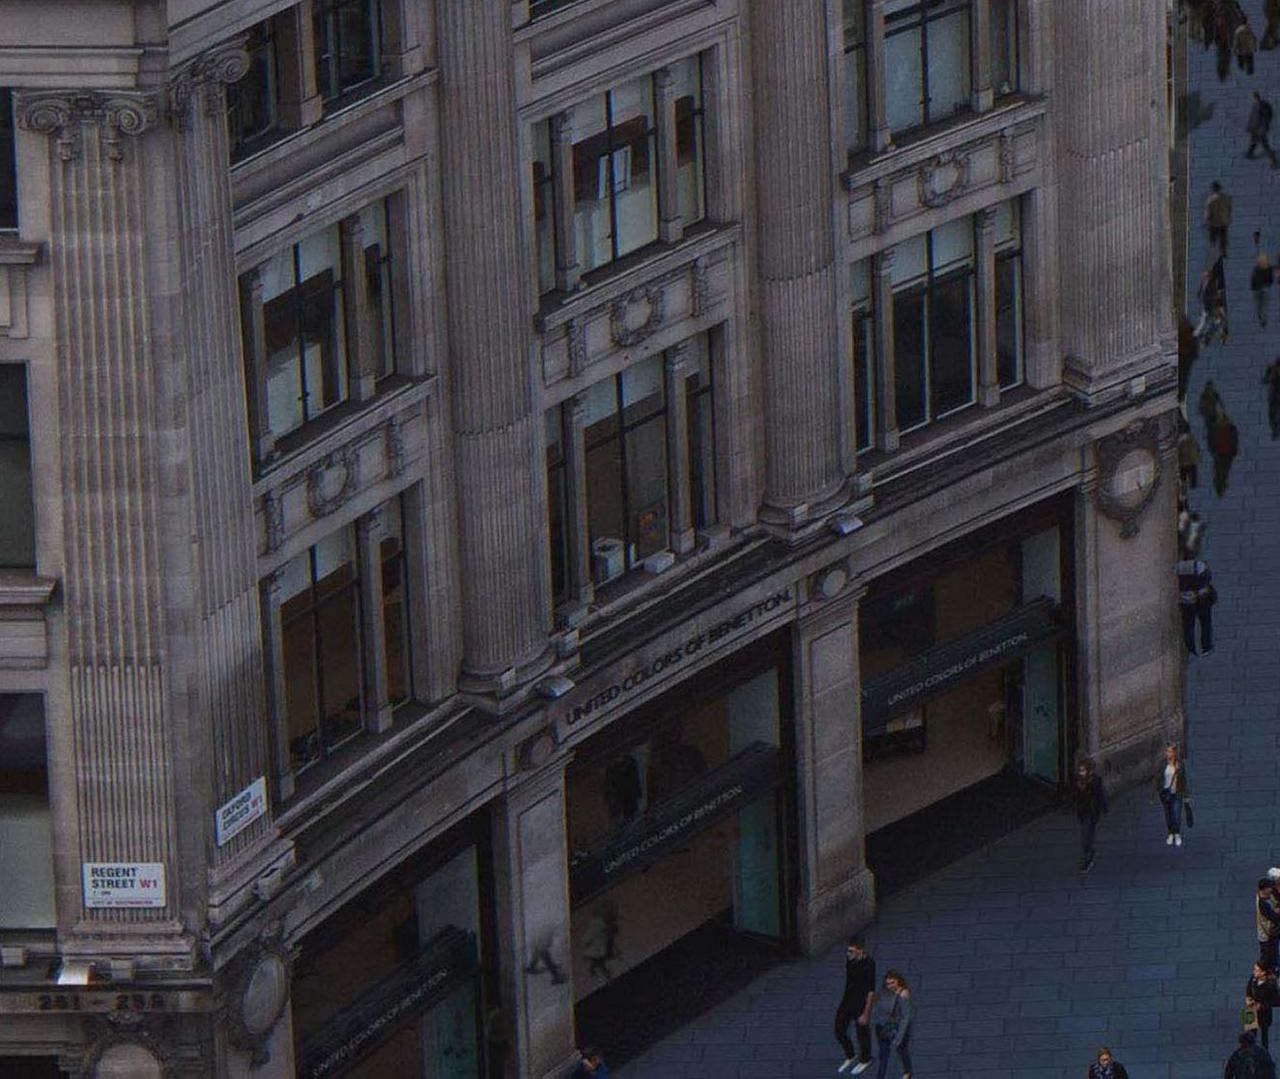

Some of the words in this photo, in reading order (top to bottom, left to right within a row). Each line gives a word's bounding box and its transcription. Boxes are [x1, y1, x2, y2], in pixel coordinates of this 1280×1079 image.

[565, 685, 620, 725] UNITED
[622, 647, 684, 691] COLORS
[685, 635, 706, 655] OF
[91, 867, 136, 878] REGENT
[91, 878, 135, 889] STREET
[139, 878, 158, 889] W1
